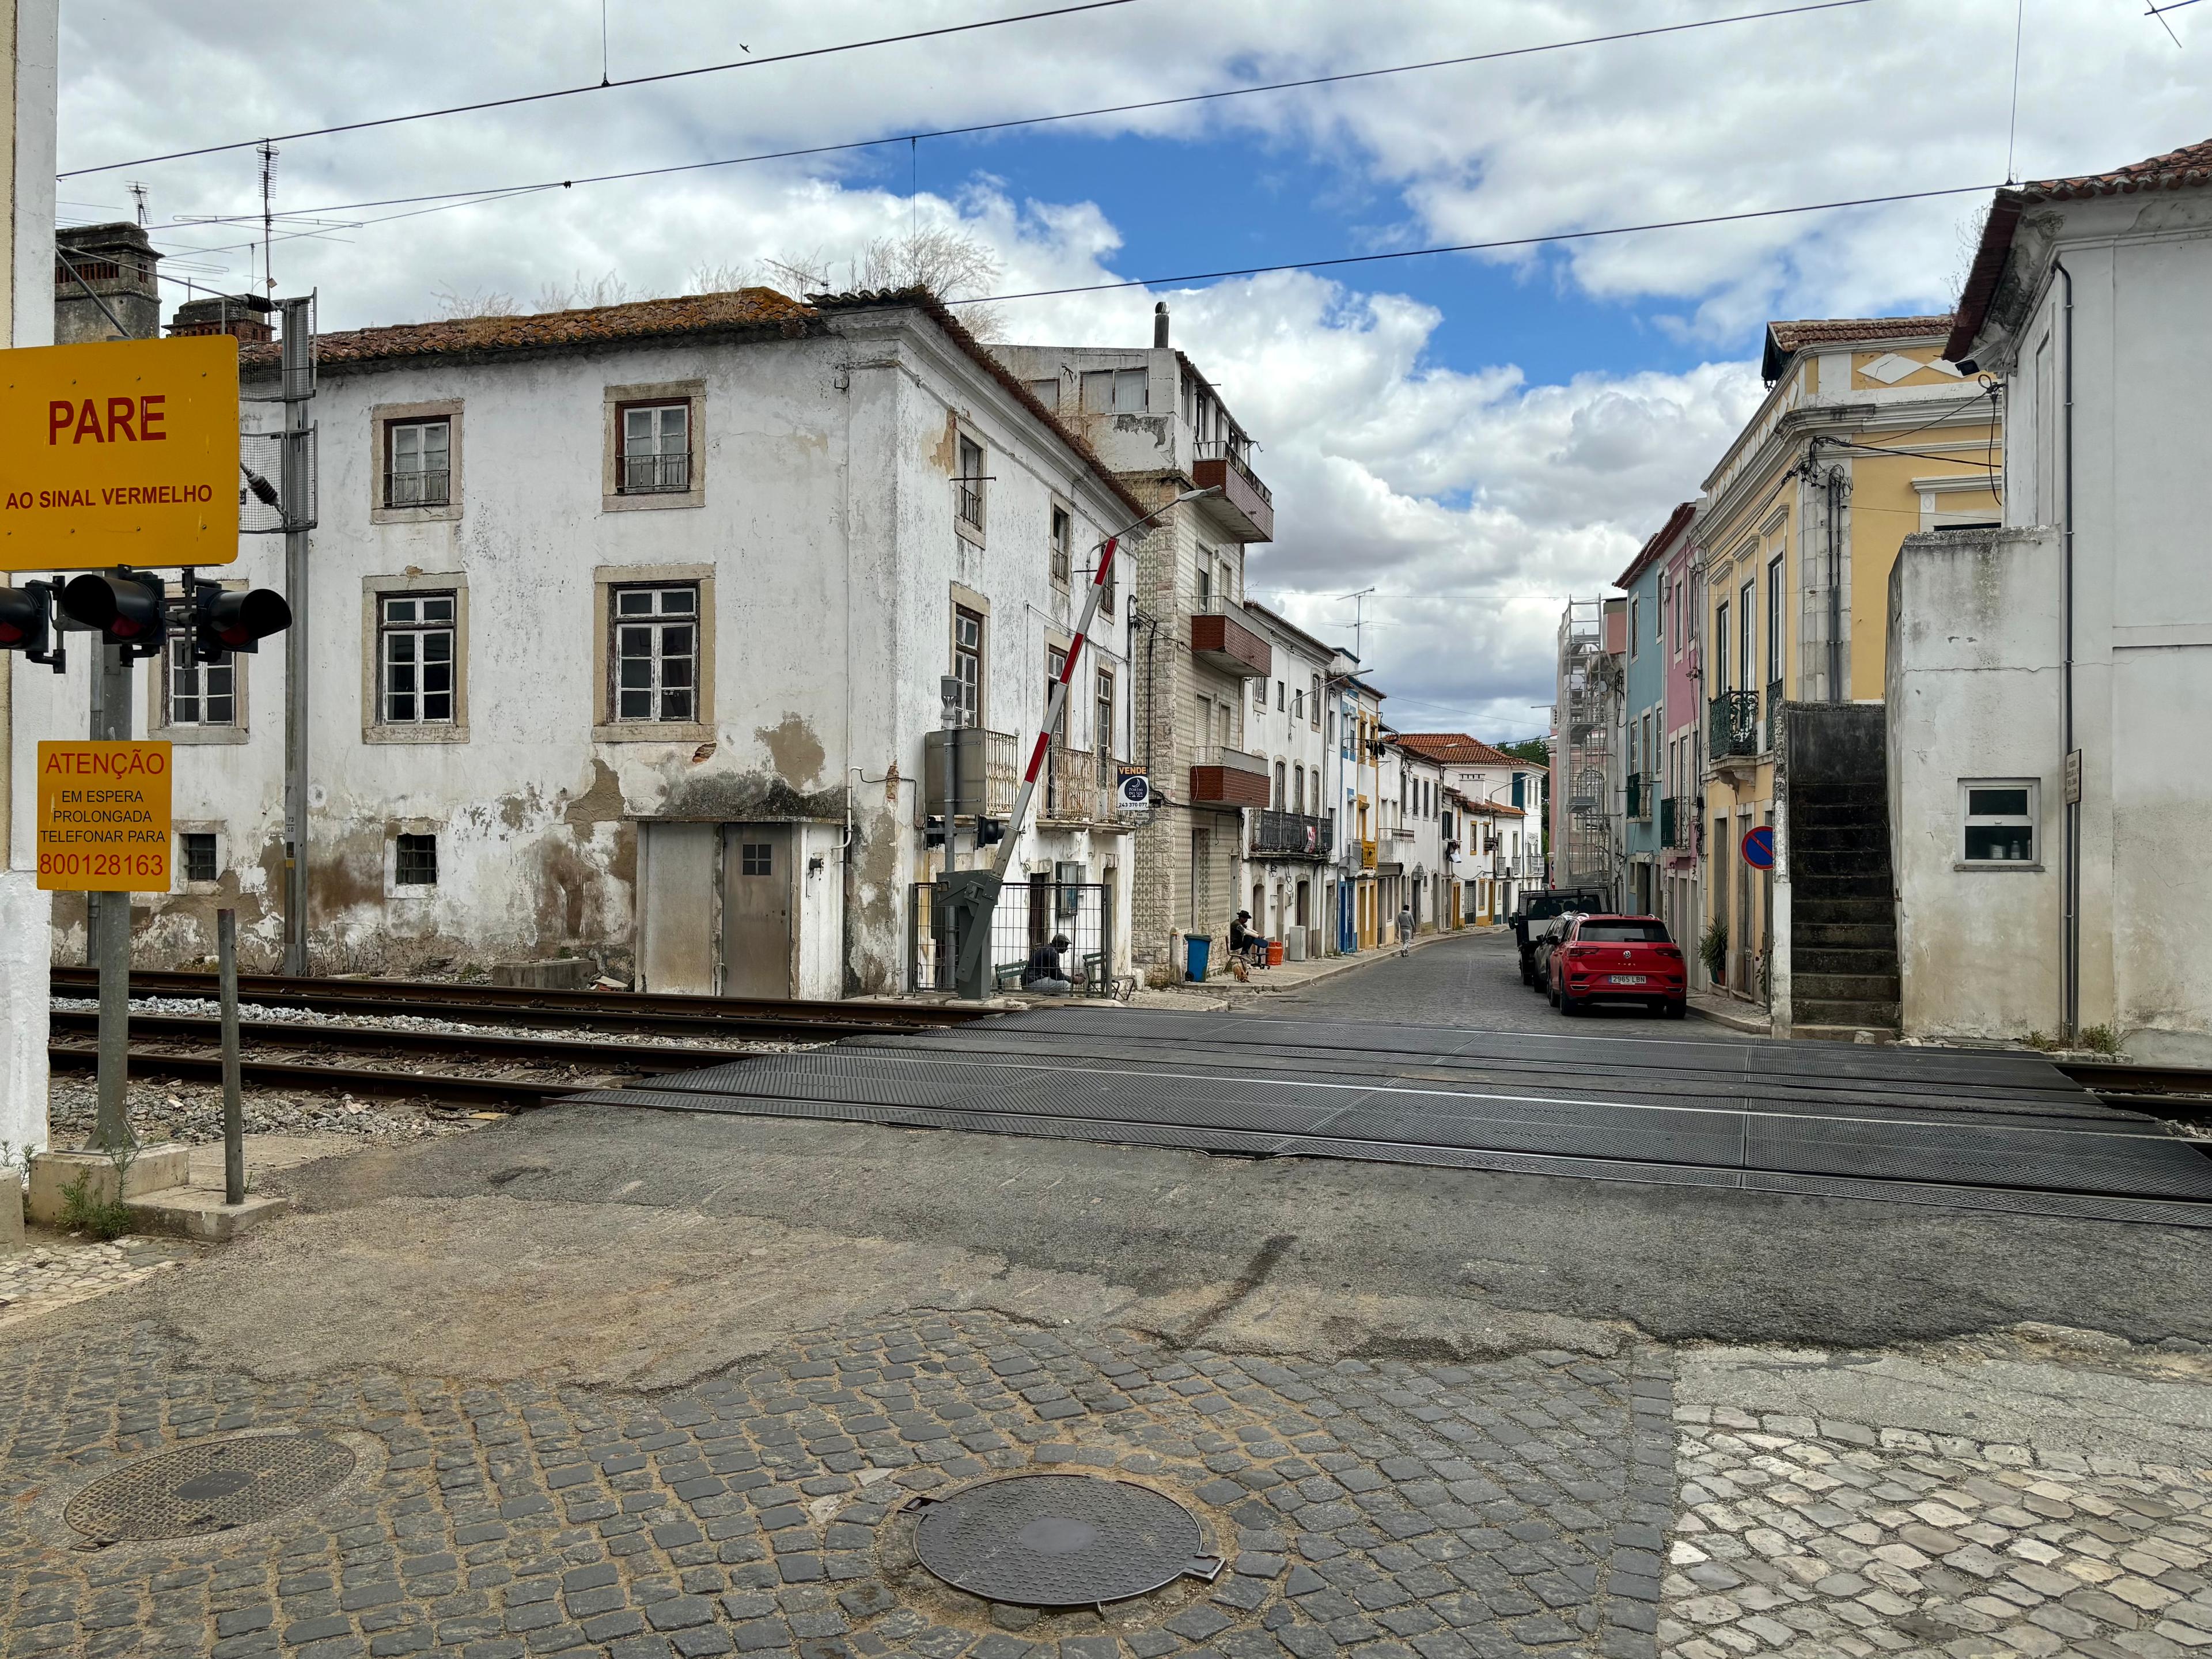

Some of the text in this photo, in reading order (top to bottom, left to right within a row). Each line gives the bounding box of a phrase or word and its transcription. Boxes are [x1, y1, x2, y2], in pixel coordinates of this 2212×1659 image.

[49, 395, 166, 445] PARE
[5, 484, 213, 510] AO SINAL VERMELHO
[46, 748, 165, 779] ATENÇÃO
[1119, 767, 1147, 775] VENDE
[62, 790, 144, 802] EM ESPERA
[54, 810, 152, 823] PROLONGADA
[40, 831, 165, 843] TELEFONAR PARA
[40, 853, 164, 876] 800128163
